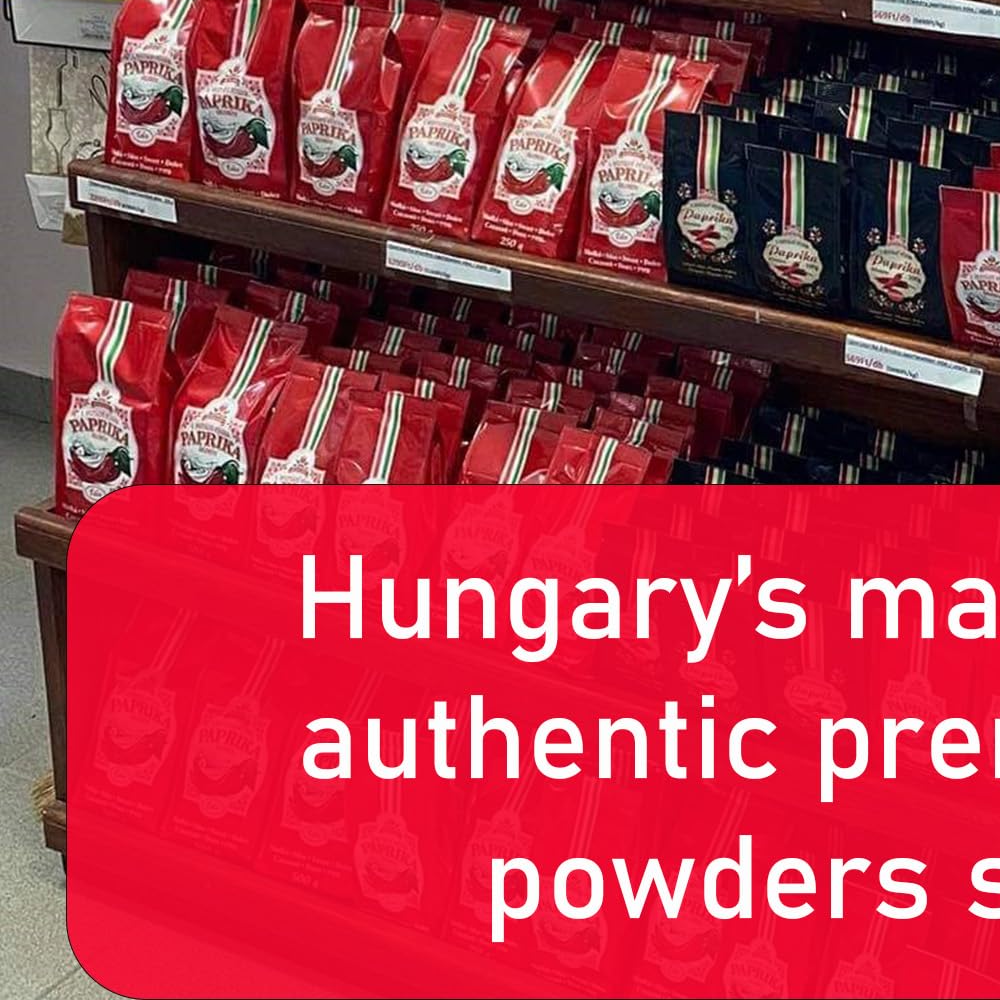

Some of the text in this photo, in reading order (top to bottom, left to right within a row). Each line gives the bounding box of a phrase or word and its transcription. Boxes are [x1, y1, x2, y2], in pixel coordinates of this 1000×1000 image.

[123, 59, 183, 85] PAPRIKA
[301, 120, 357, 146] PAPRIKA
[409, 126, 471, 151] PAPRIKA
[509, 136, 571, 166] PAPRIKA
[598, 165, 661, 190] PAPRI
[69, 416, 130, 447] PAPRIKA
[180, 430, 241, 461] PAPRIKA
